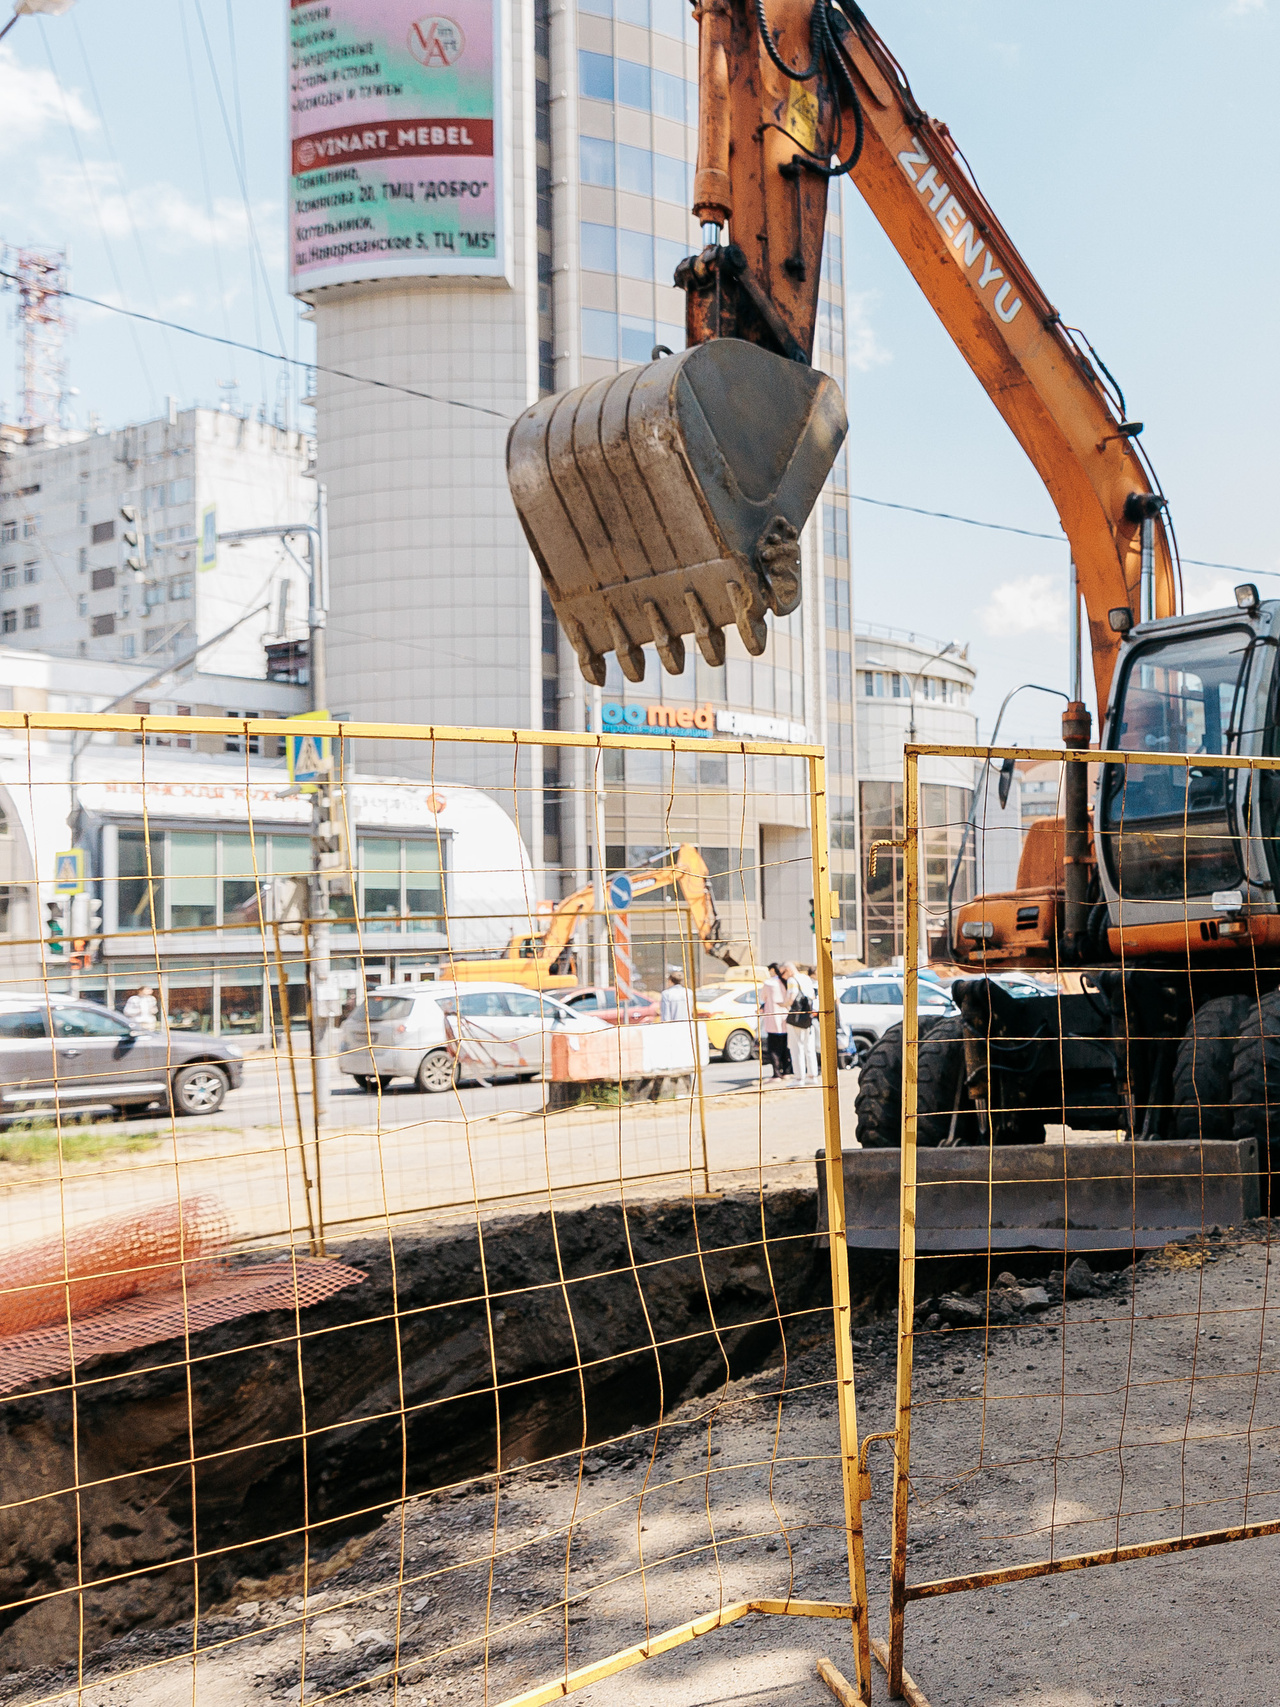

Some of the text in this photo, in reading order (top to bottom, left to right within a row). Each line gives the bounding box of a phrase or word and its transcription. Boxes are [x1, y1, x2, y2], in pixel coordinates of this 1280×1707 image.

[433, 231, 455, 252] ТЦ
[897, 136, 1023, 324] ZHENYU
[587, 702, 713, 730] oomed
